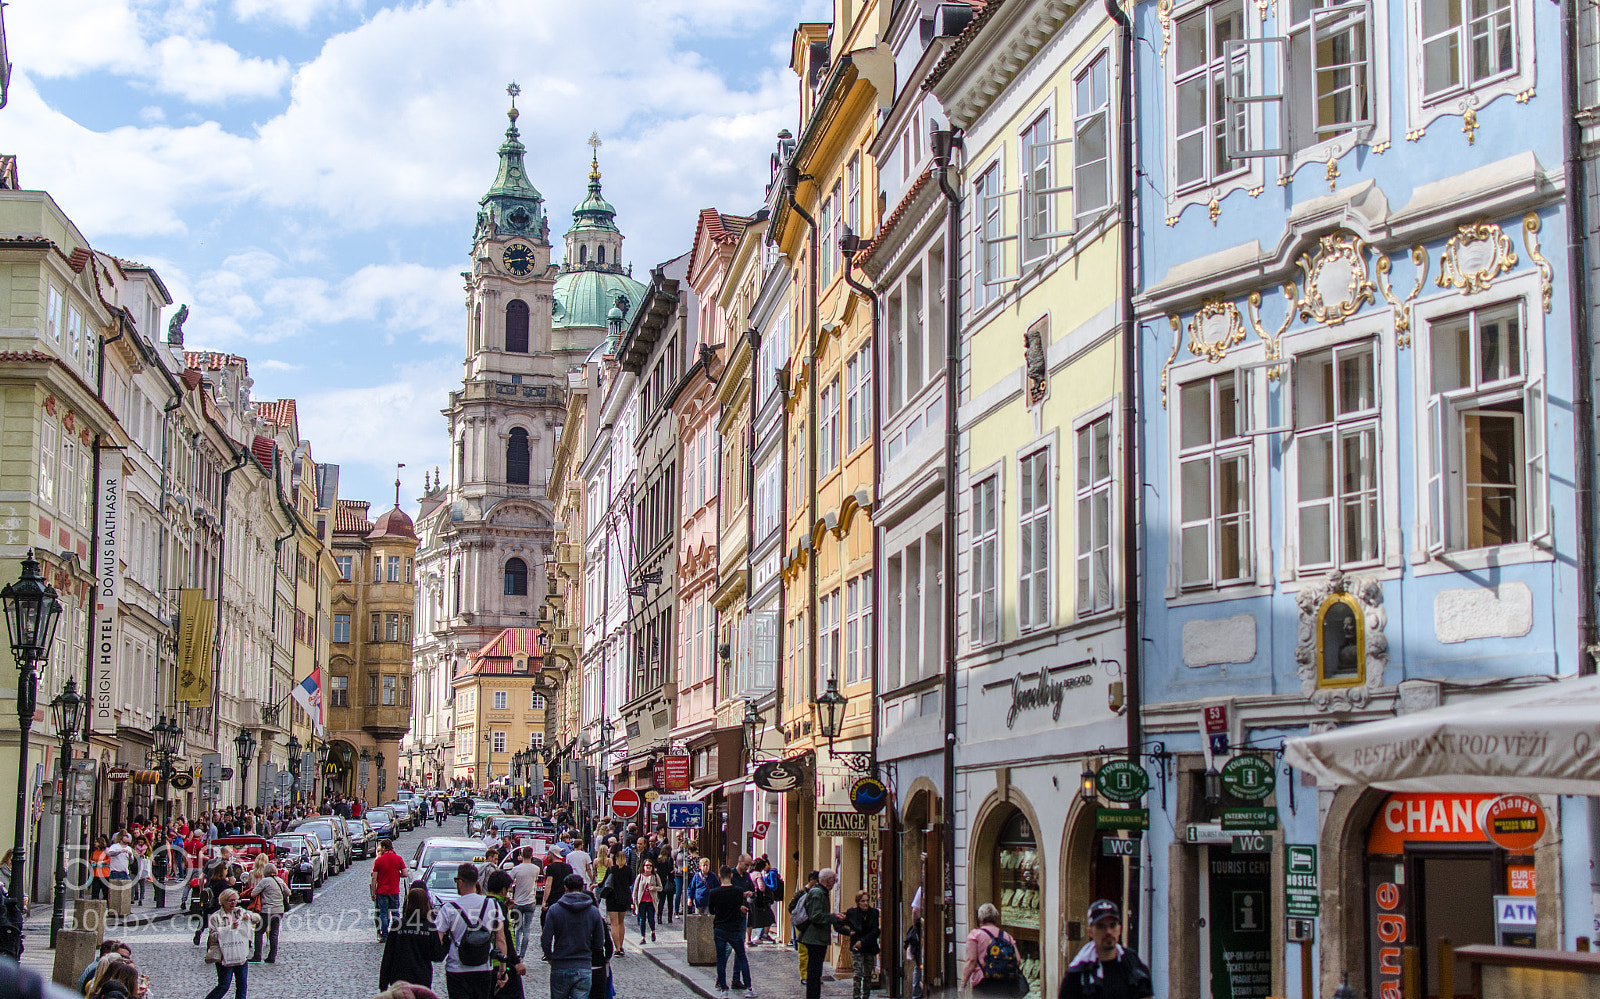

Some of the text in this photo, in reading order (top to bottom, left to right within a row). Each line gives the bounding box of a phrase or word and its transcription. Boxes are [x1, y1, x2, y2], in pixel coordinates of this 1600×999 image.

[103, 478, 117, 598] DOMUS BALTHASAR
[98, 617, 113, 719] DESIGN HOTEL
[1210, 707, 1220, 719] 53
[1214, 737, 1220, 748] 4
[1353, 735, 1455, 767] RESTAURANT
[1458, 734, 1499, 756] POD
[1503, 731, 1550, 758] VĚŽÍ
[1102, 762, 1144, 777] TOURIST INFO
[1227, 759, 1270, 773] TOURIST INFO
[108, 771, 130, 780] ANTIQUE
[1492, 799, 1537, 815] change
[820, 812, 866, 830] CHANGE
[1110, 840, 1133, 855] WC
[1239, 836, 1265, 851] WC
[1211, 860, 1246, 874] TOURIST
[1286, 874, 1318, 887] HOSTEL
[1511, 870, 1528, 880] EUR
[1511, 880, 1529, 889] CZK
